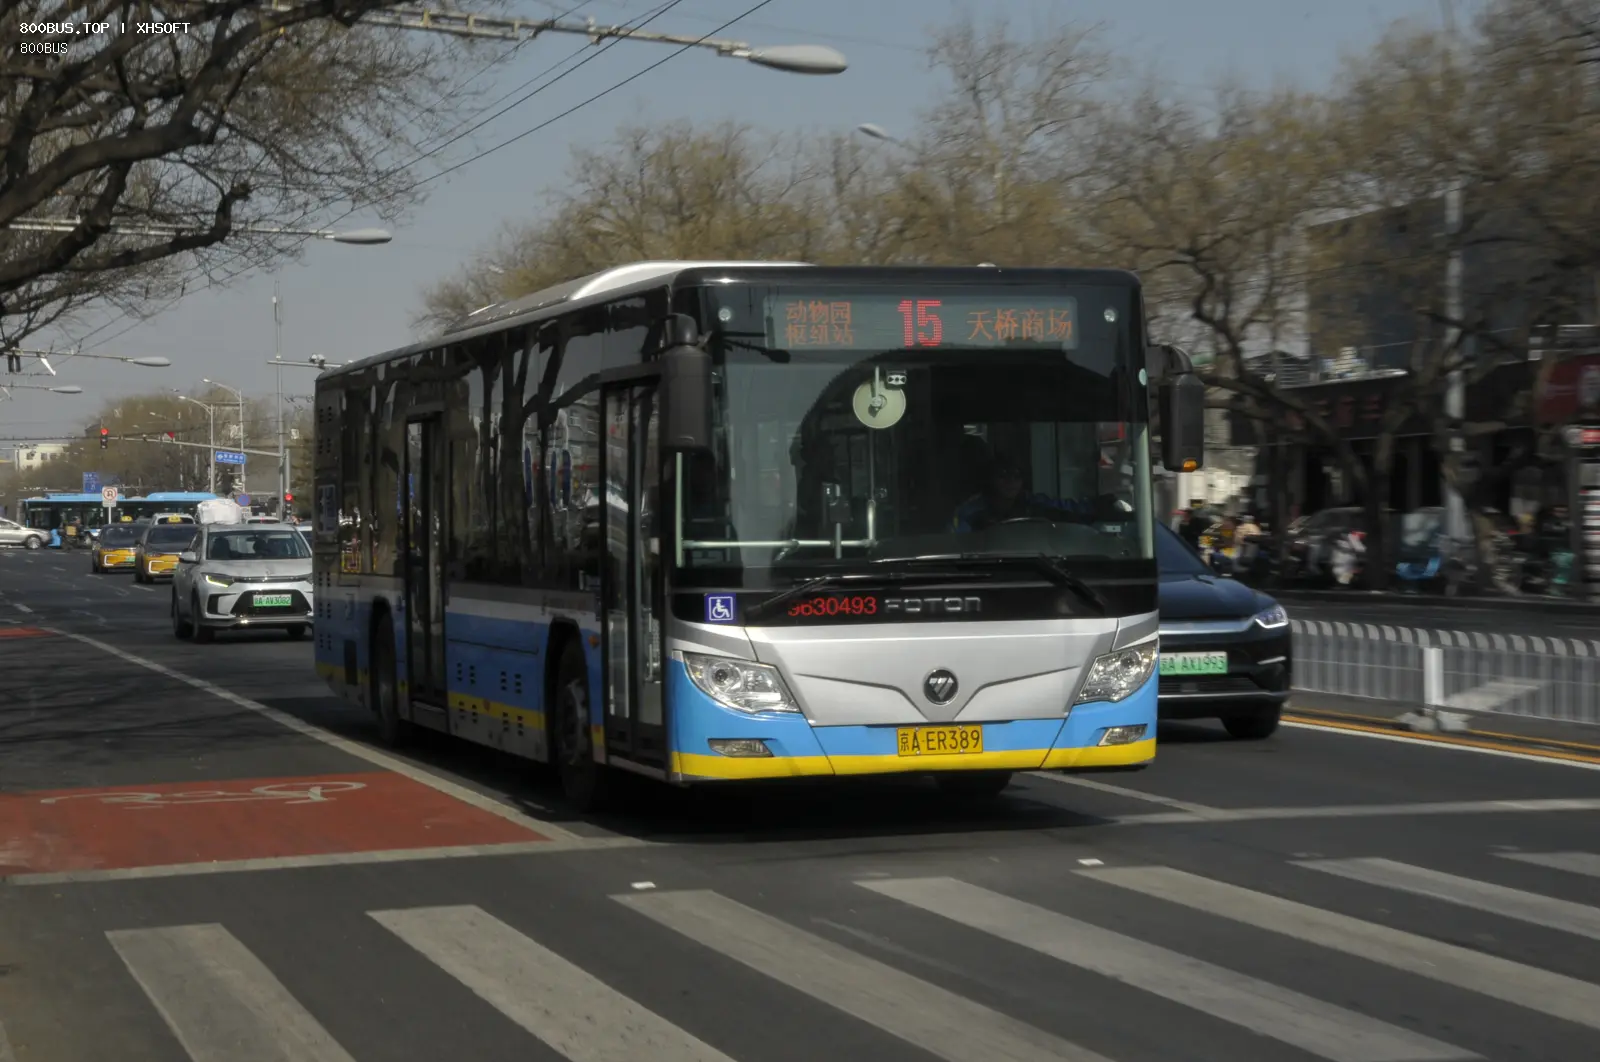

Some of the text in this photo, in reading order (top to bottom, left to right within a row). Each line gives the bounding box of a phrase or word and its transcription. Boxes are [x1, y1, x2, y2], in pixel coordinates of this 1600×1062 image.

[785, 300, 852, 324] 动物园
[897, 299, 943, 347] 15
[965, 307, 1072, 341] 天桥商场
[884, 596, 981, 612] FOTON
